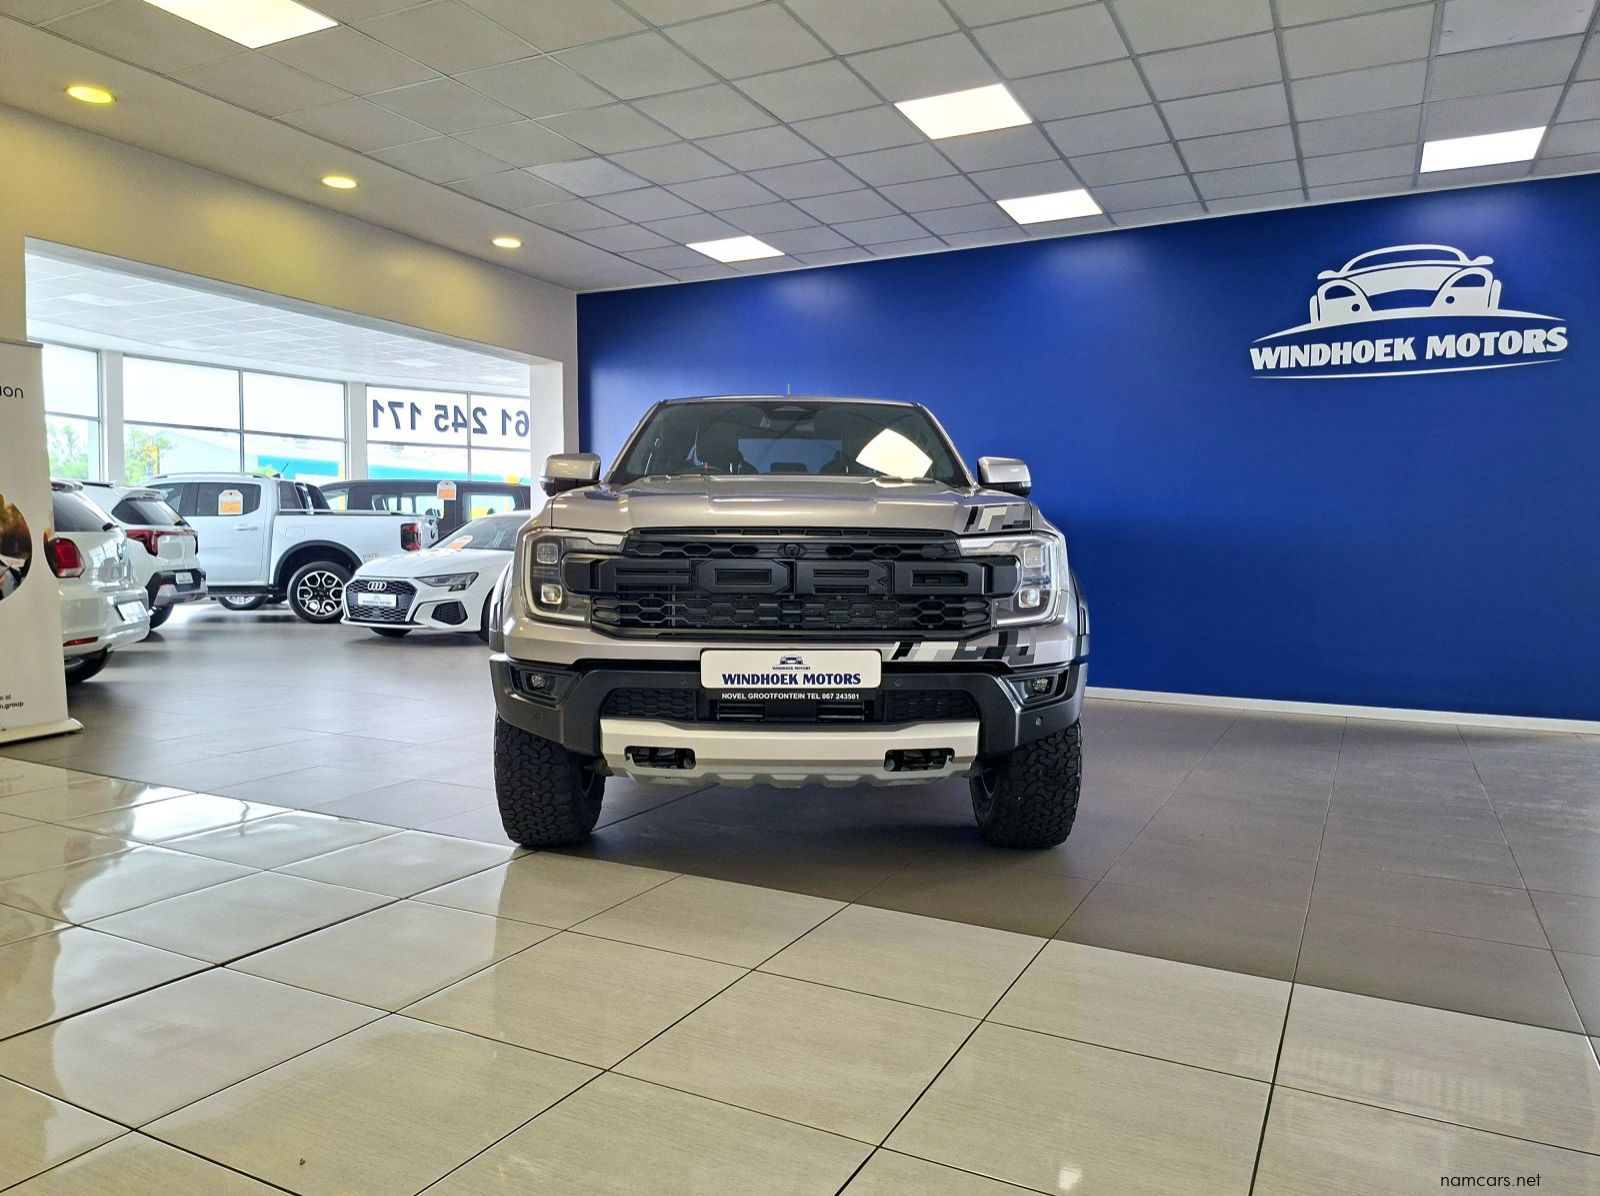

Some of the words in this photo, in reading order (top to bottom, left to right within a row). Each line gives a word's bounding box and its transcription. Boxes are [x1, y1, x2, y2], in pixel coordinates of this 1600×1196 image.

[1249, 337, 1416, 371] WINDHOEK
[1425, 326, 1569, 360] MOTORS
[722, 673, 799, 685] WINDHOEK
[803, 673, 861, 685] MOTORS
[721, 692, 747, 700] NOVEL
[747, 692, 806, 700] GROOTFONTEIN
[807, 692, 821, 700] TEL
